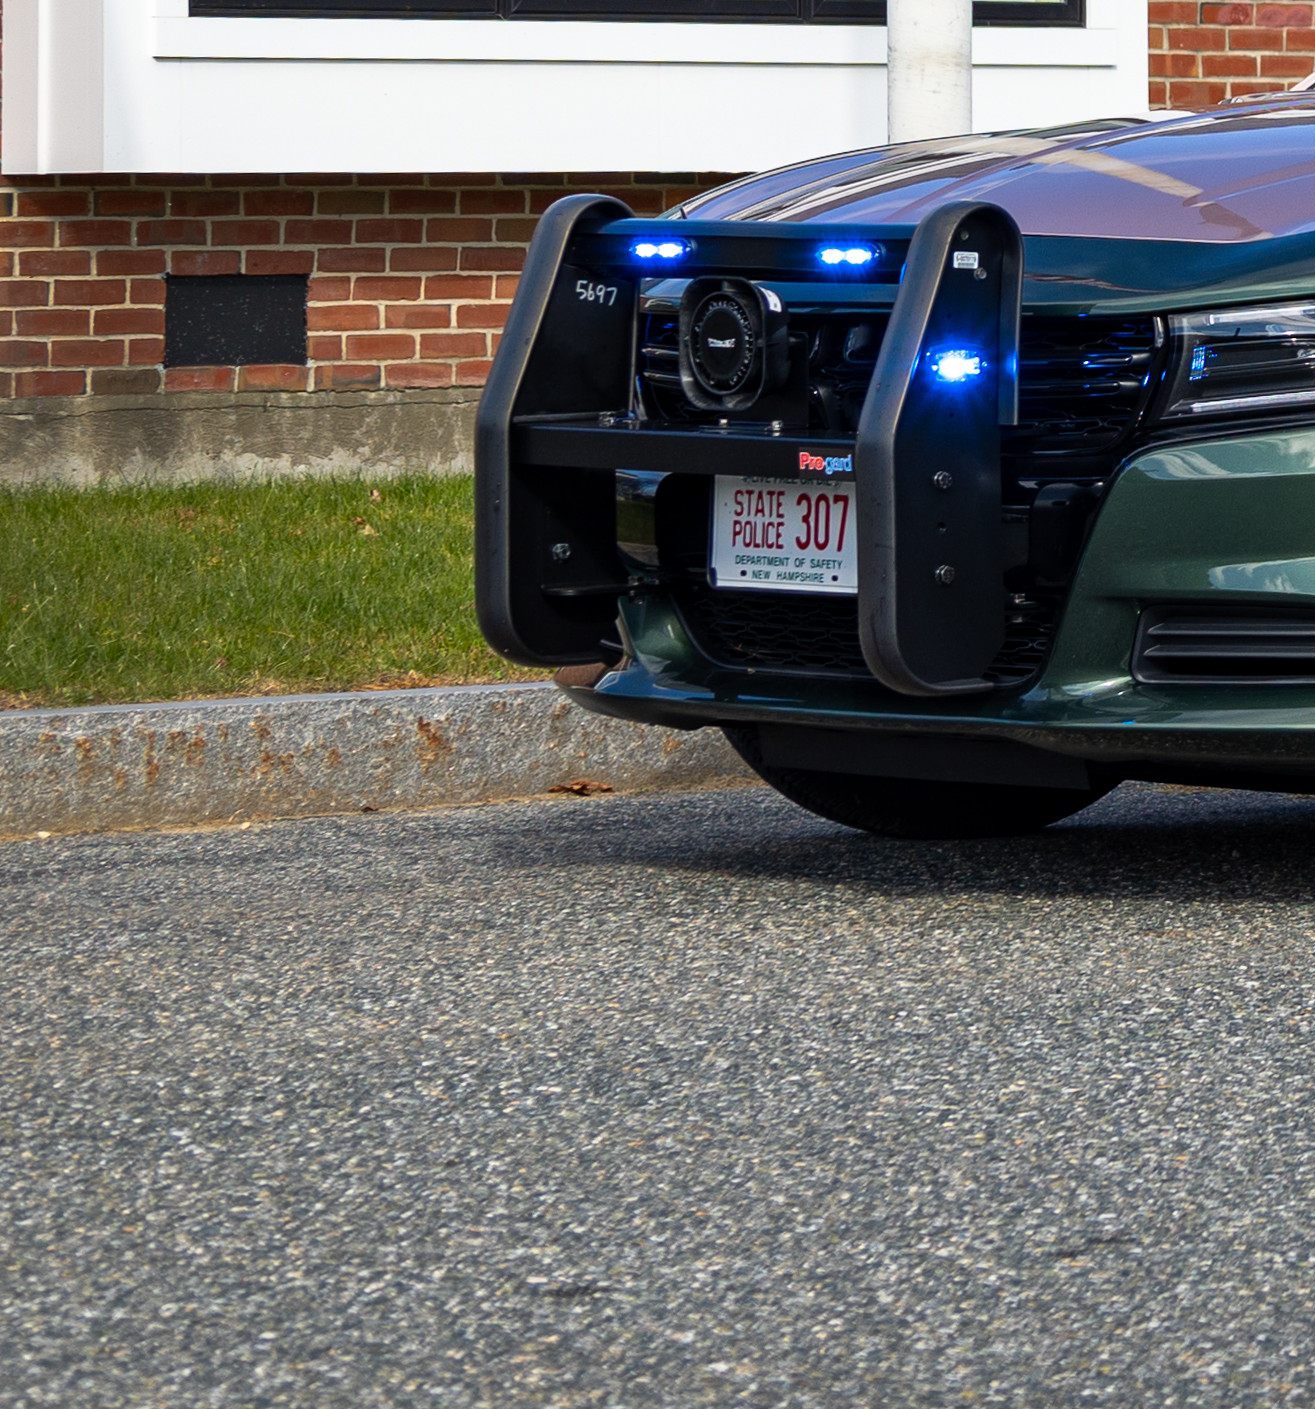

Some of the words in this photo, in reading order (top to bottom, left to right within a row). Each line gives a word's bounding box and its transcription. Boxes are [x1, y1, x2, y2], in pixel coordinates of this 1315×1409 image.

[576, 280, 617, 306] 5697
[733, 490, 785, 519] STATE
[732, 520, 785, 549] POLICE
[795, 493, 849, 552] 307
[735, 555, 789, 567] DEPARTMENT
[794, 558, 806, 568] OF
[810, 559, 843, 569] SAFETY
[751, 570, 770, 580] NEW
[776, 571, 824, 583] HAMPSHIRE
